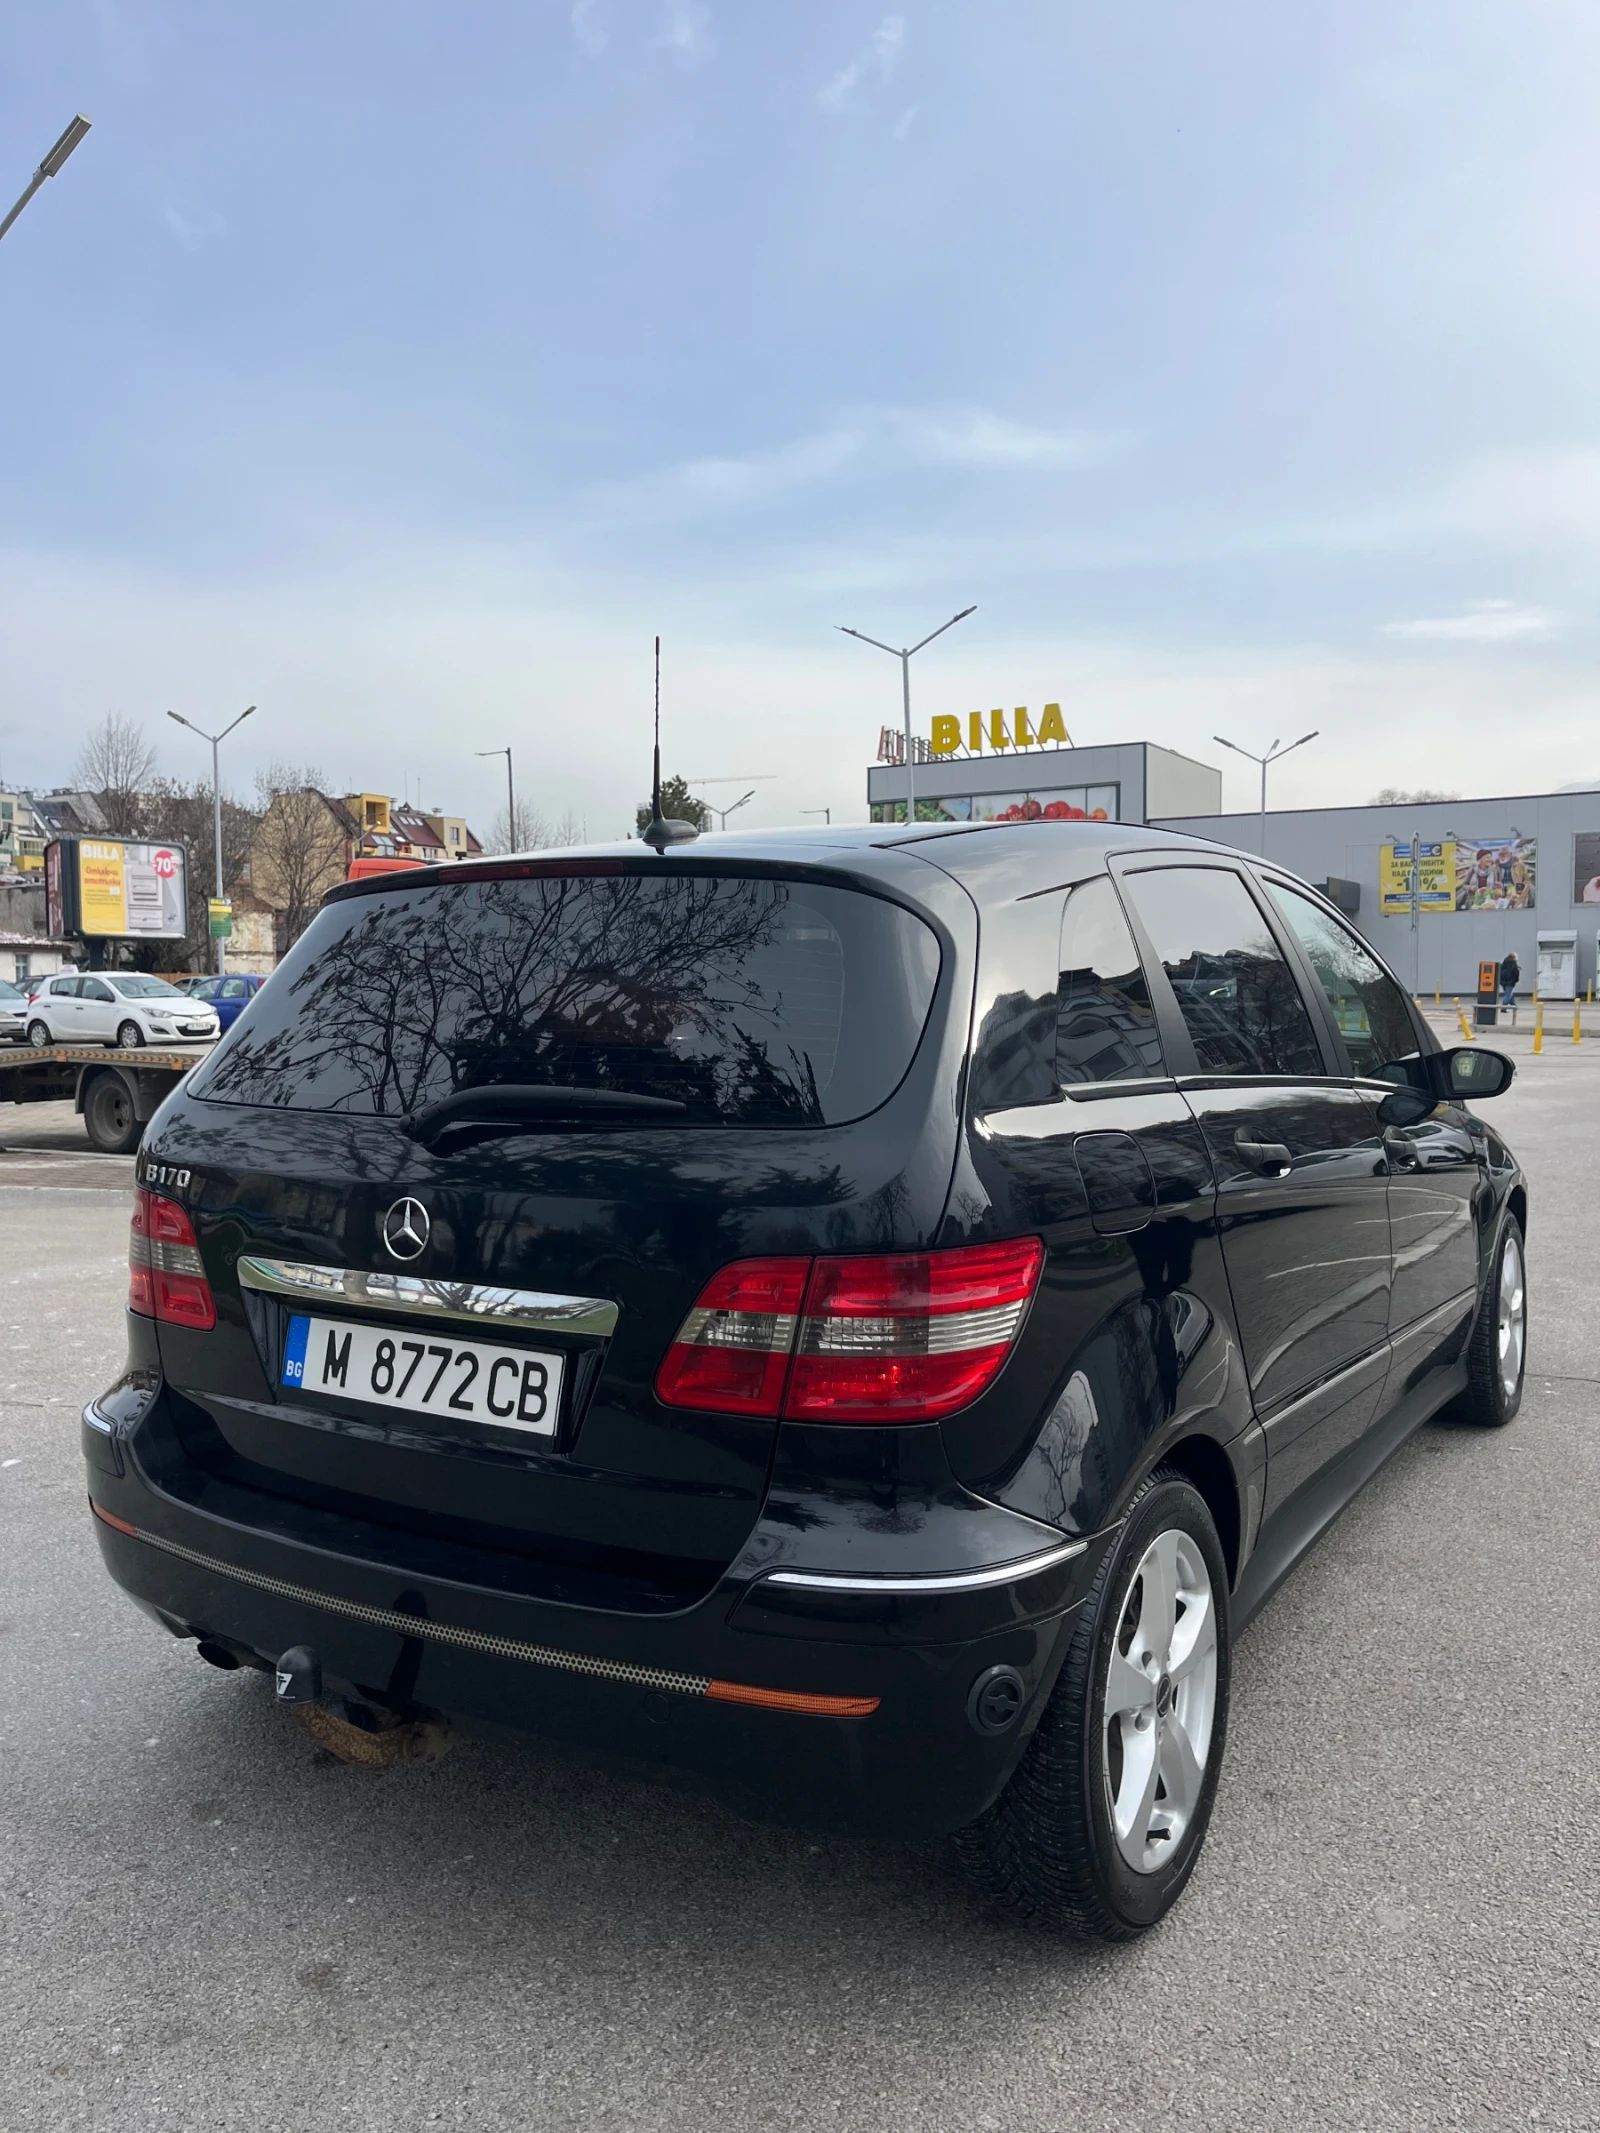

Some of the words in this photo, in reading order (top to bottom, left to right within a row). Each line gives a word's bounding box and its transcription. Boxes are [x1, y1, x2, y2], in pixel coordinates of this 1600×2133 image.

[931, 703, 1068, 754] BILLA
[82, 844, 119, 860] BILLA
[146, 1164, 191, 1188] B170
[285, 1360, 302, 1377] BG
[322, 1329, 353, 1388] M
[371, 1338, 480, 1411] 8772
